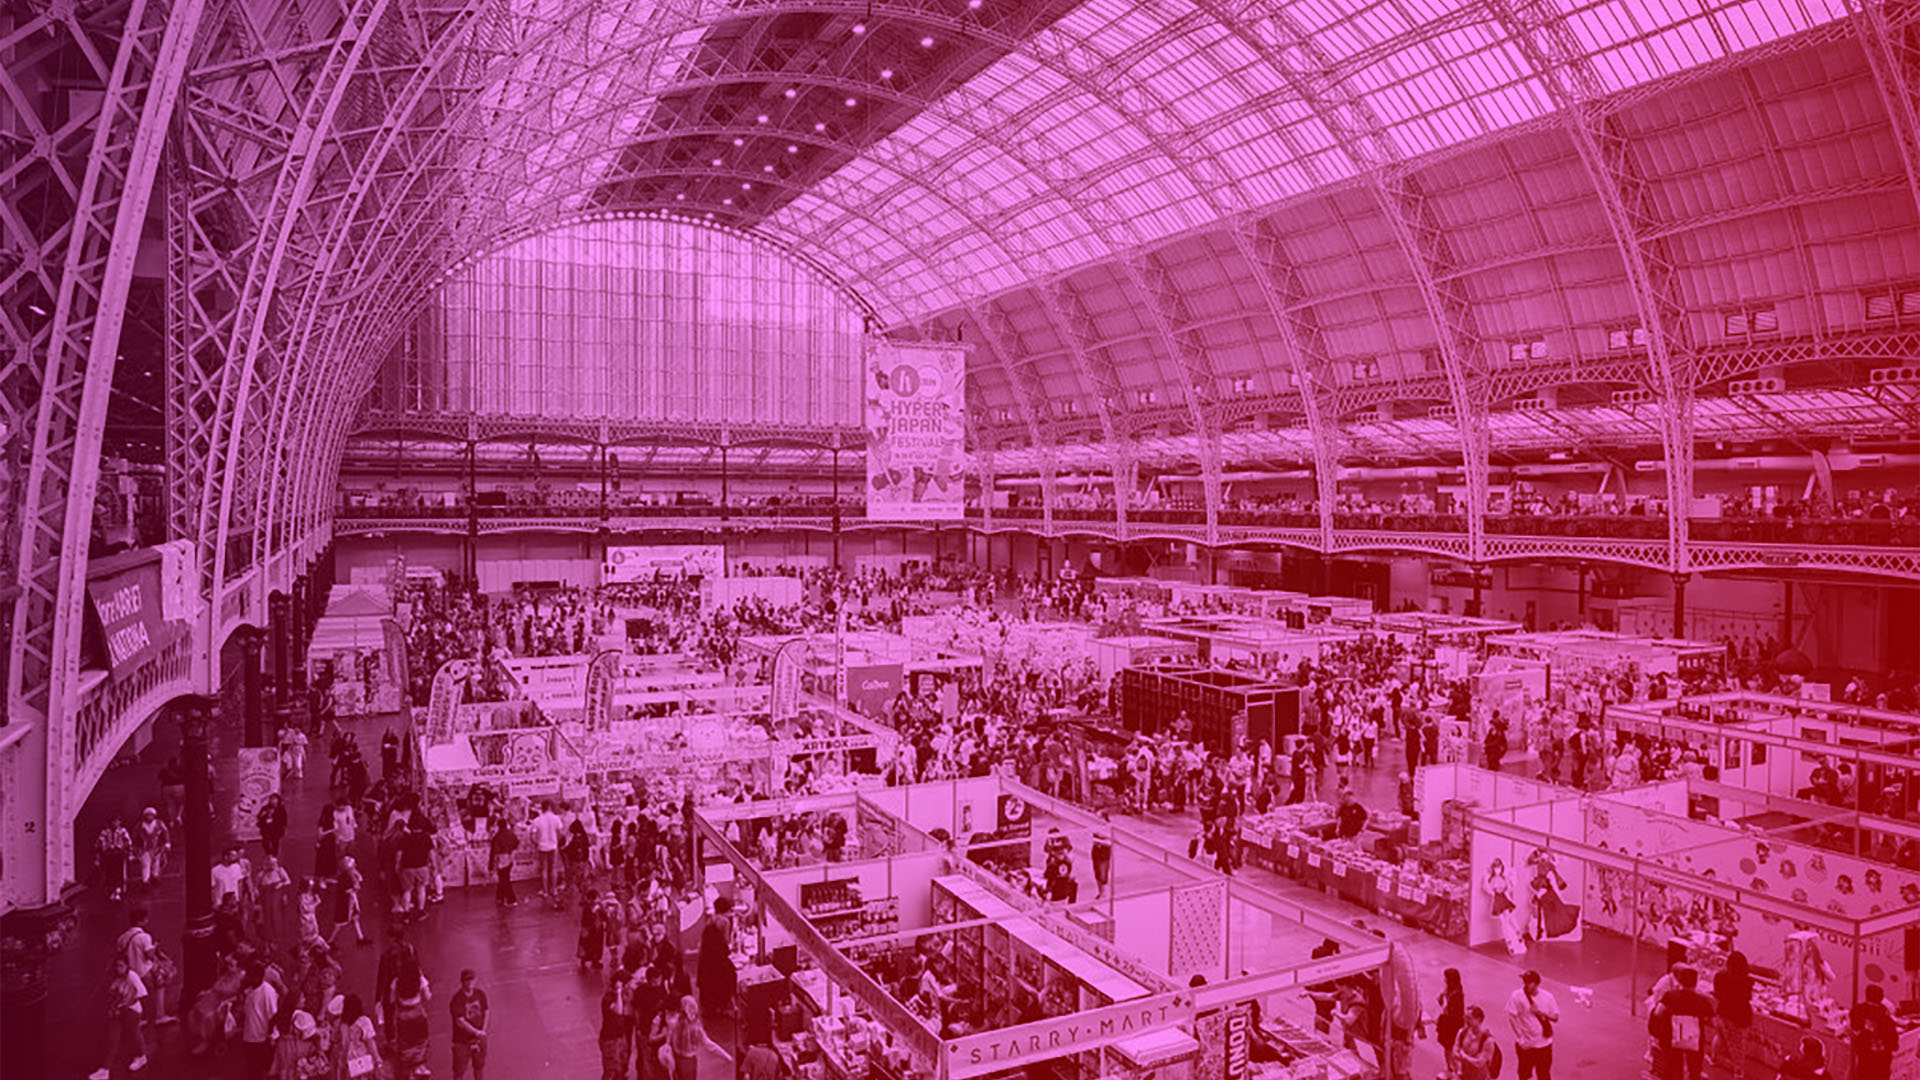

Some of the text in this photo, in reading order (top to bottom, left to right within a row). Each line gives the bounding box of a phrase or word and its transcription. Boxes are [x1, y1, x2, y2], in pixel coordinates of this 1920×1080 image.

[891, 401, 942, 417] HYPER
[890, 417, 942, 434] JAPAN
[803, 740, 848, 750] ARTBOX
[970, 1006, 1169, 1065] STARRY MART
